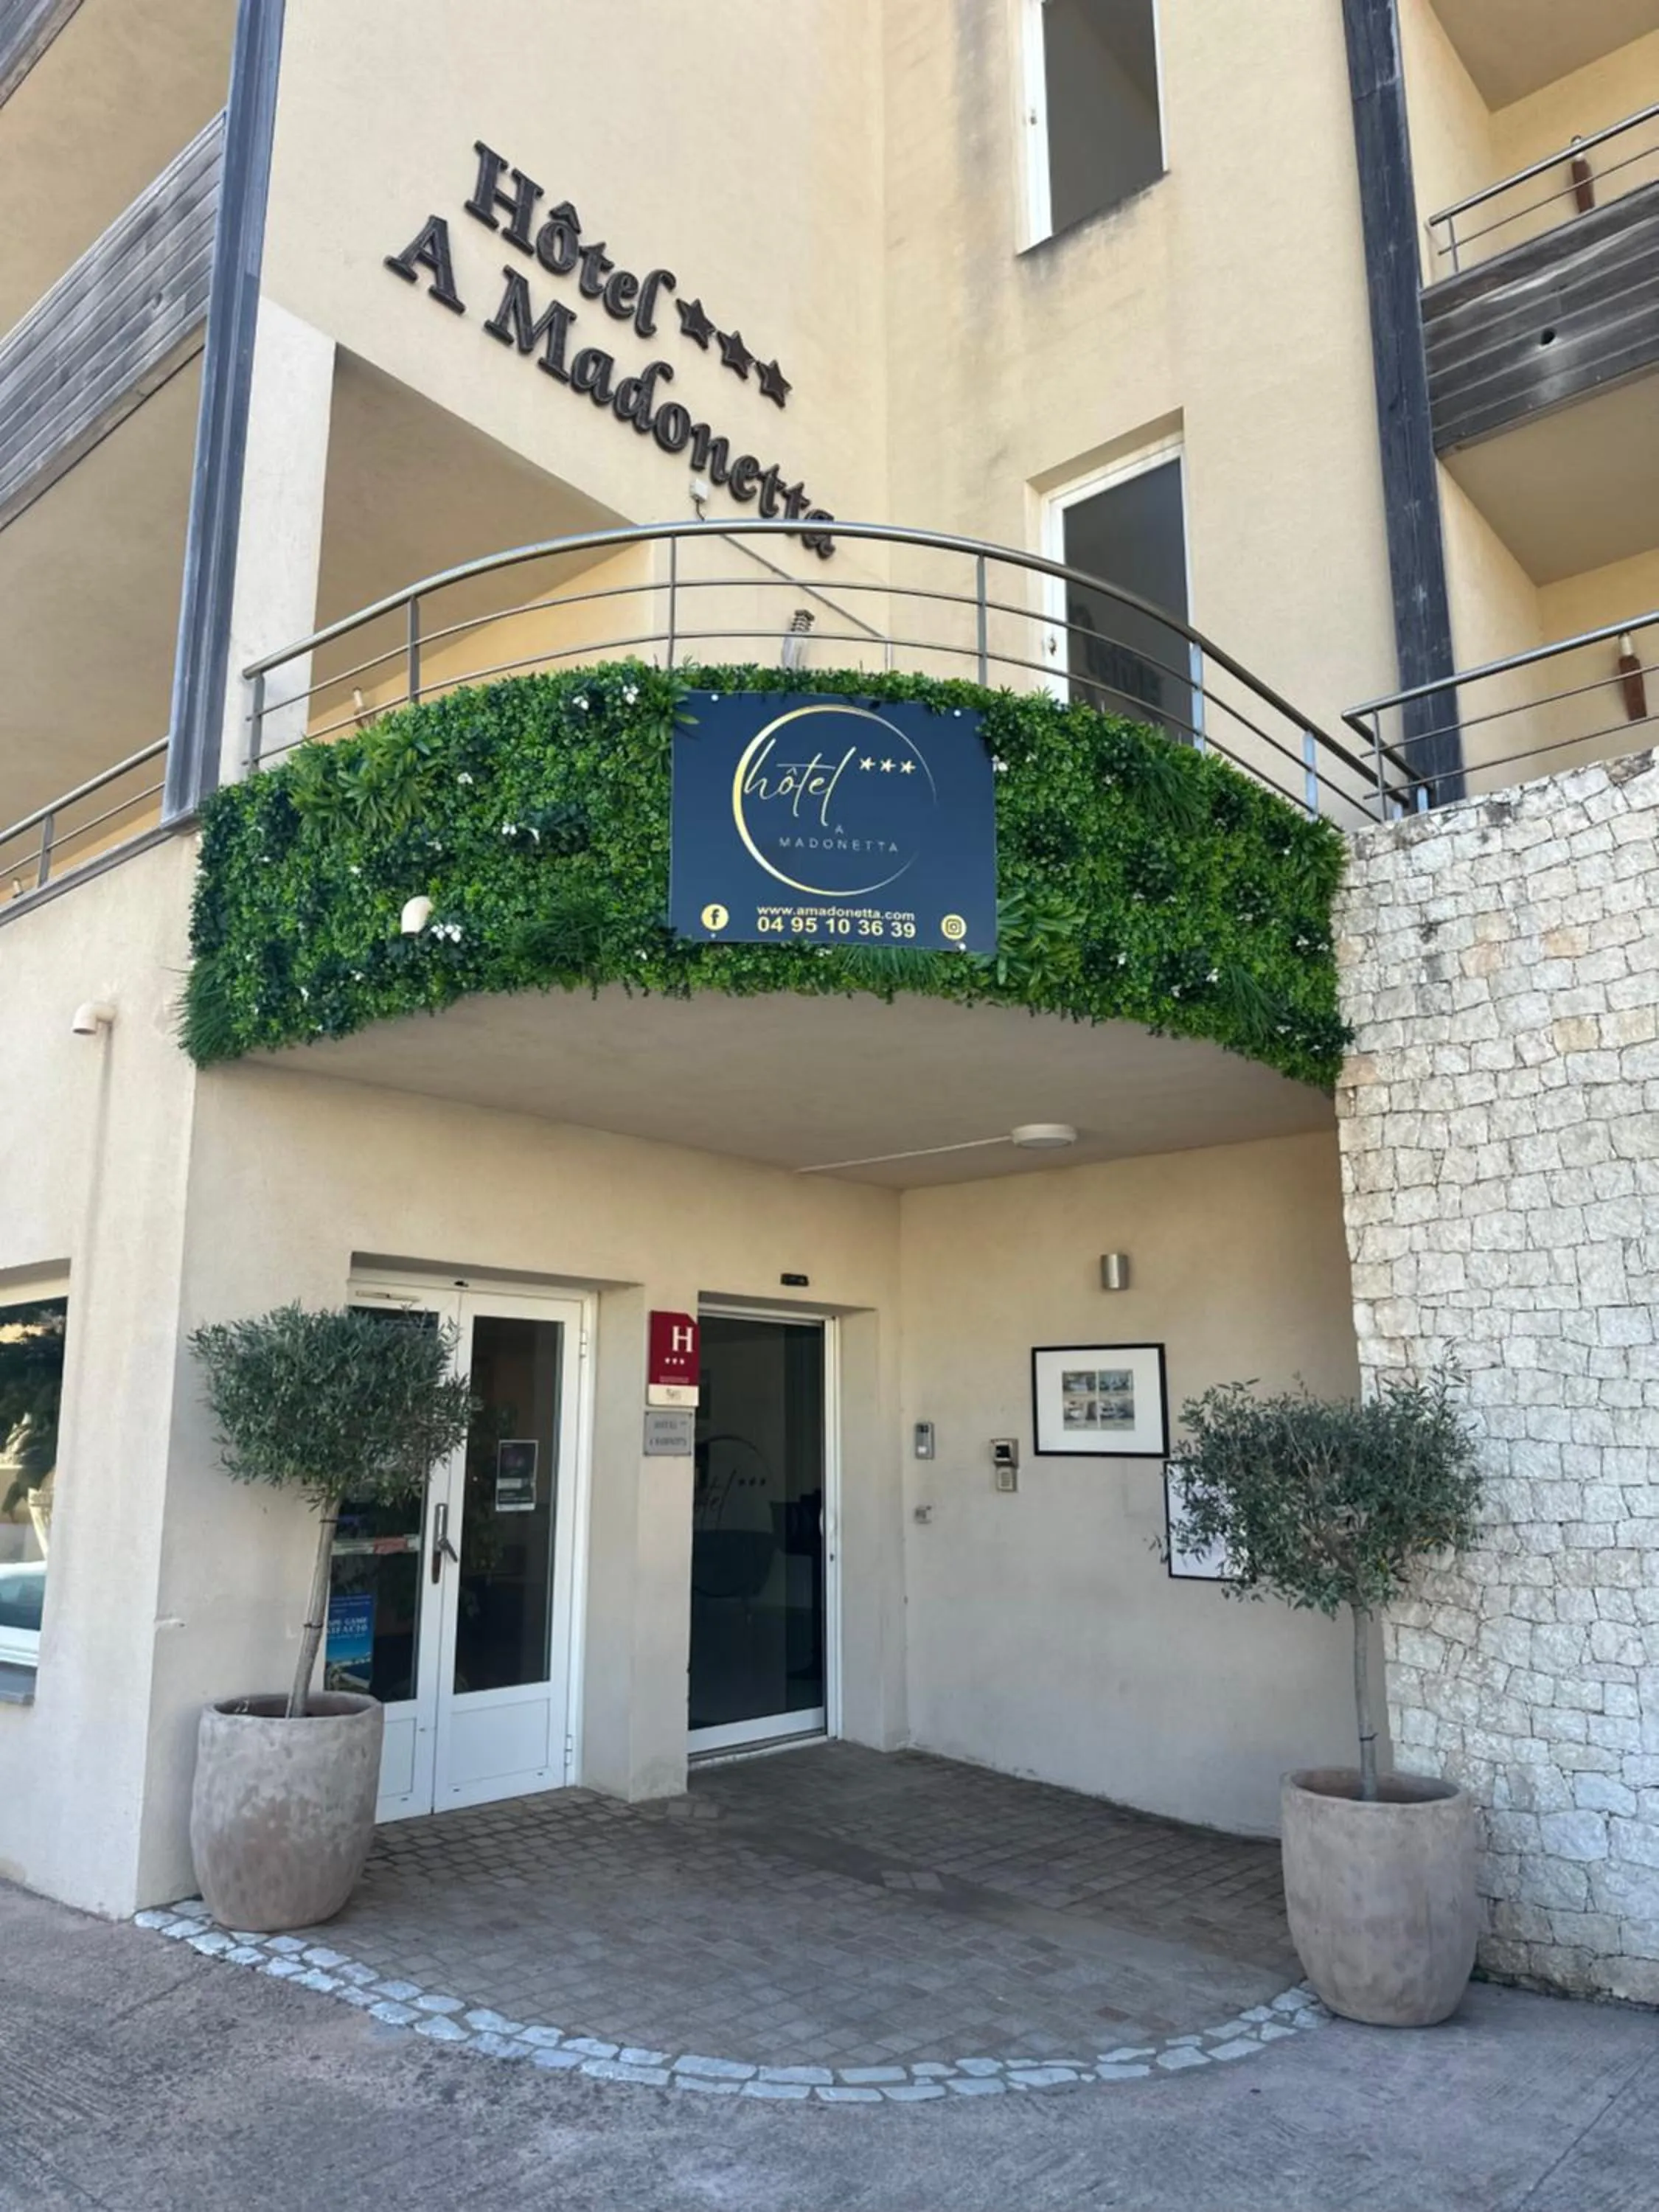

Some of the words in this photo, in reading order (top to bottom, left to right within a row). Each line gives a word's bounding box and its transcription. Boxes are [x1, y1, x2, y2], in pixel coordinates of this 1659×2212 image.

[464, 139, 676, 339] Hôtel
[383, 215, 467, 316] A
[483, 264, 837, 560] Madonetta
[835, 824, 844, 835] A
[779, 837, 899, 852] MADONETTA
[757, 905, 916, 921] www.amadonetta.com
[757, 917, 784, 933] 04
[790, 917, 818, 933] 95
[825, 919, 850, 934] 10
[858, 919, 883, 936] 36
[891, 922, 916, 939] 39
[672, 1325, 694, 1353] H
